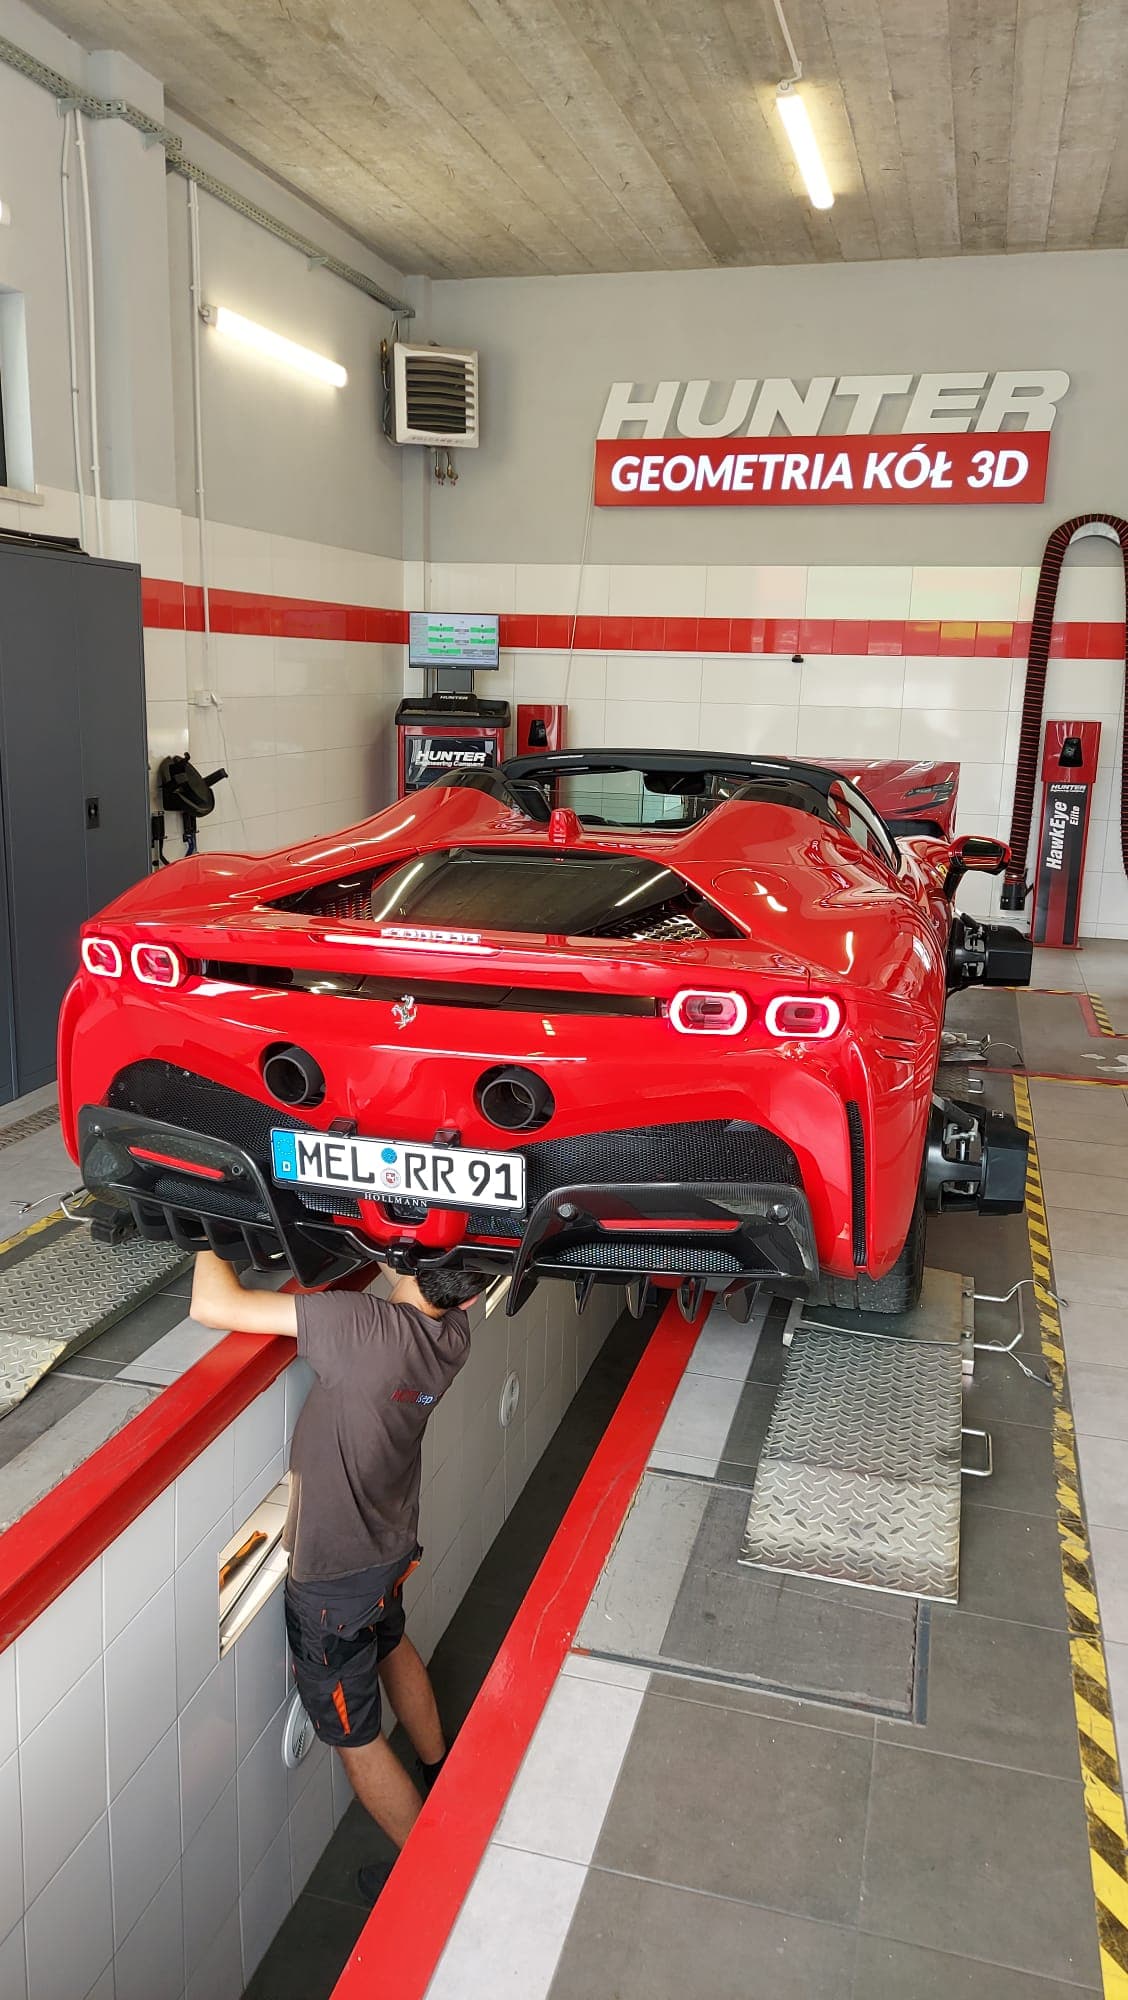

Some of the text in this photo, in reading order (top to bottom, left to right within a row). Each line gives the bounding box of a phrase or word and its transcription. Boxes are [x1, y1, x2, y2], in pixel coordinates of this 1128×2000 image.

[596, 369, 1071, 439] HUNTER
[610, 443, 1029, 493] GEOMETRIA KÓŁ 3D
[415, 750, 487, 762] HUNTER
[1045, 801, 1069, 870] HawkEye
[1070, 805, 1080, 826] Elite
[298, 1140, 518, 1201] MEL RR 91
[364, 1192, 428, 1208] HOLLMANN
